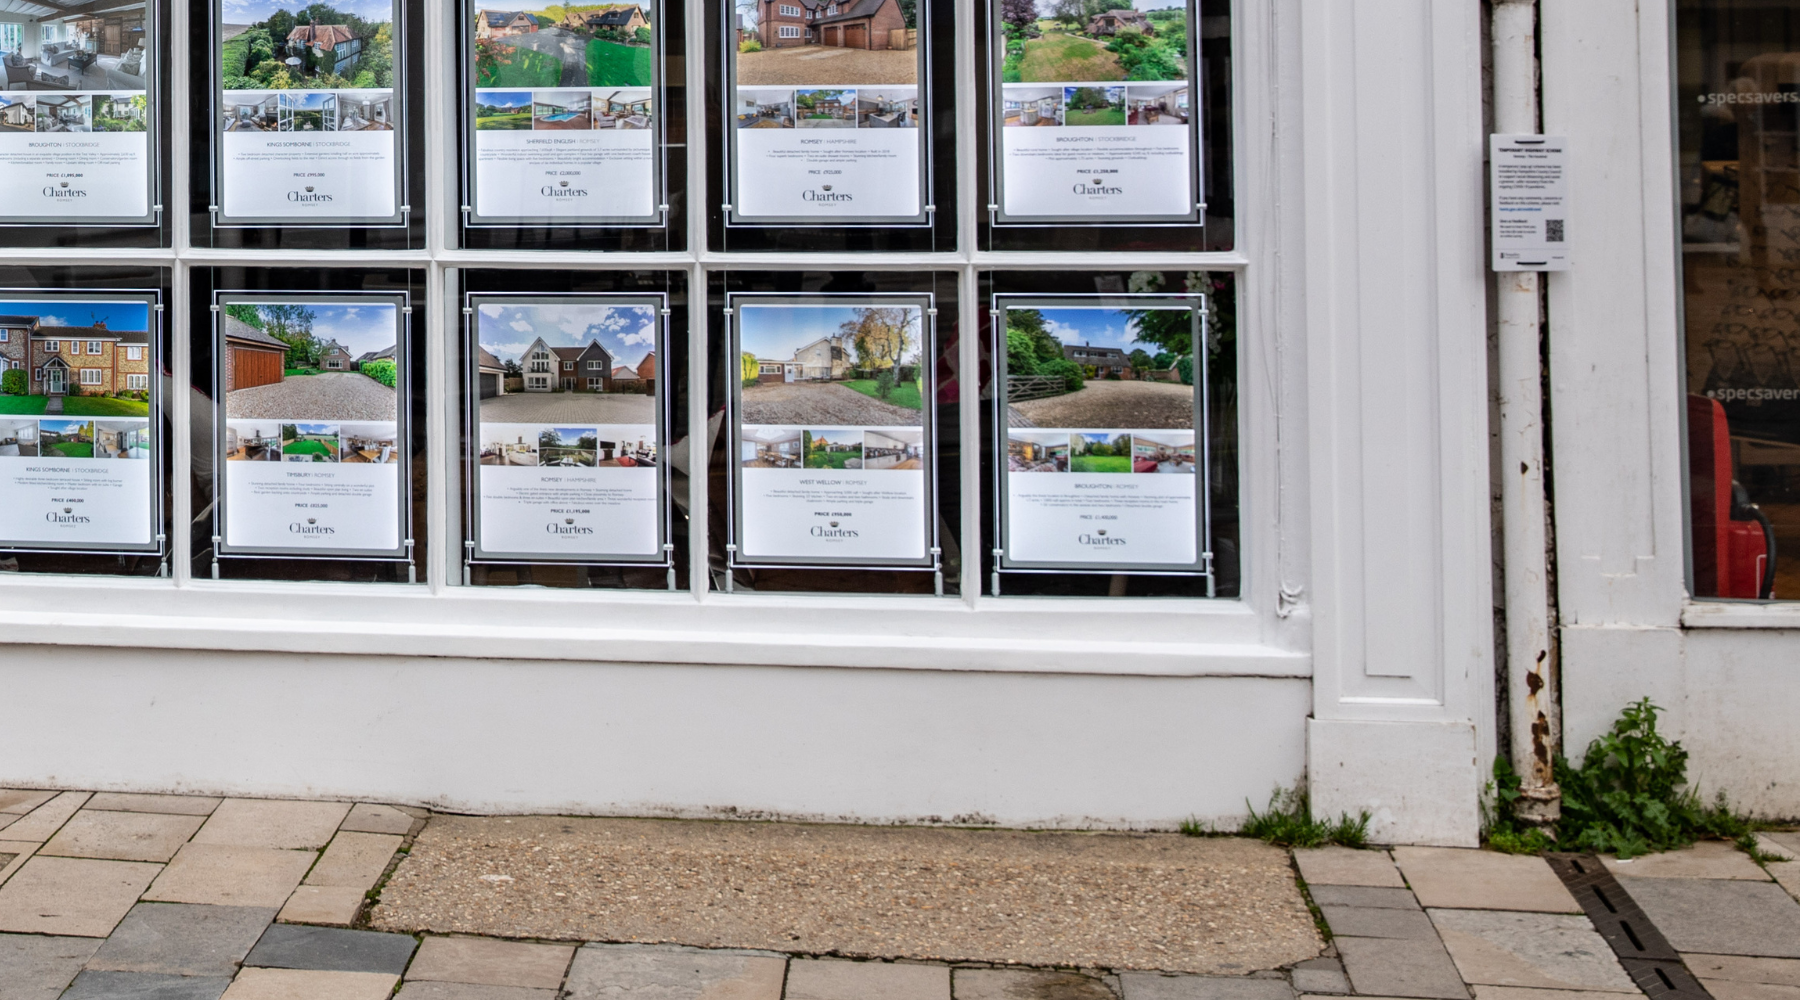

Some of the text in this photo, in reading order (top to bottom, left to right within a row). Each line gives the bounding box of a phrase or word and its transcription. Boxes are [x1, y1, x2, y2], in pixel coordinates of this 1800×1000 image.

[43, 186, 86, 197] Charters
[541, 186, 587, 197] Charters
[1073, 183, 1122, 195] Charters
[287, 191, 332, 202] Charters
[803, 189, 852, 201] Charters
[46, 512, 90, 523] Charters
[290, 522, 334, 534] Charters
[547, 523, 593, 534] Charters
[811, 526, 858, 537] Charters
[1079, 534, 1126, 545] Charters
